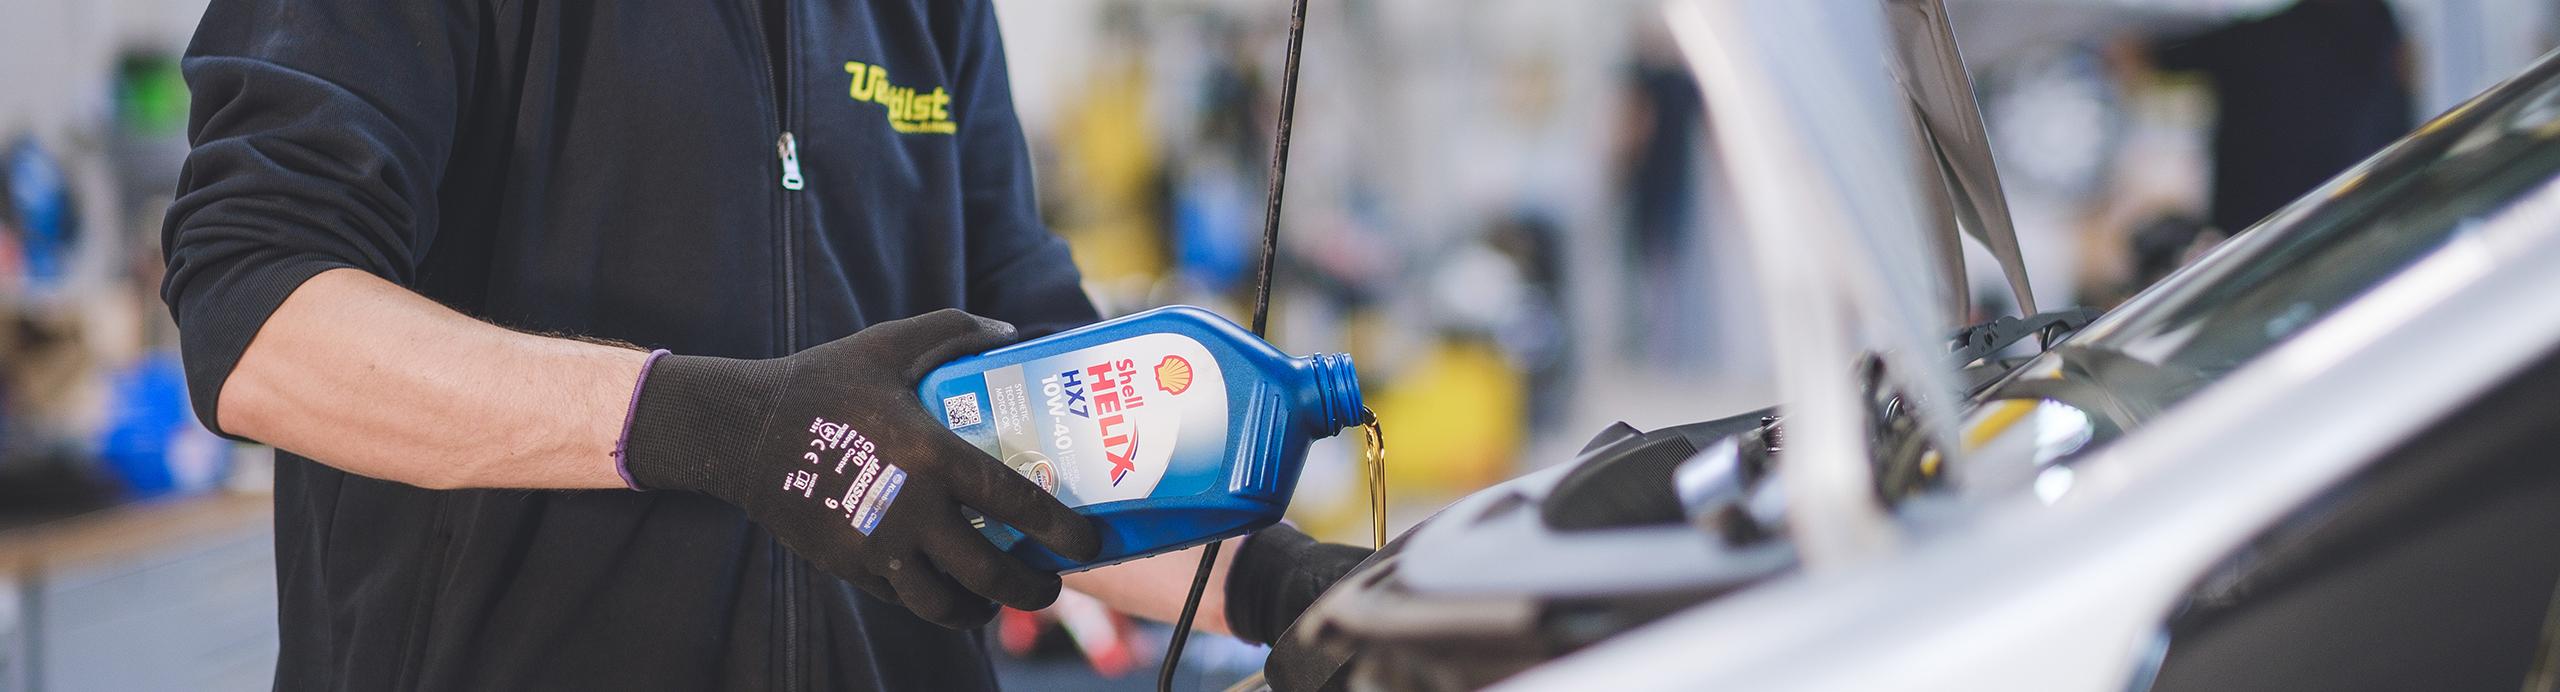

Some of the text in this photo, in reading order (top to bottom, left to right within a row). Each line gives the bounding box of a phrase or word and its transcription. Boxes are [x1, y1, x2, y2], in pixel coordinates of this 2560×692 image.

[1015, 384, 1029, 421] SYNTHETIC
[1062, 370, 1089, 418] HX7
[1116, 359, 1143, 409] Shell
[995, 388, 1010, 429] MOTOR OIL
[1005, 386, 1023, 435] TECHNOLOGY
[1042, 375, 1072, 449] 10W-40
[1087, 361, 1138, 487] HELIX
[835, 435, 865, 474] PU Coated
[841, 430, 857, 448] Glove
[853, 439, 874, 466] G40
[824, 497, 839, 510] 9
[845, 457, 881, 513] JACKSON
